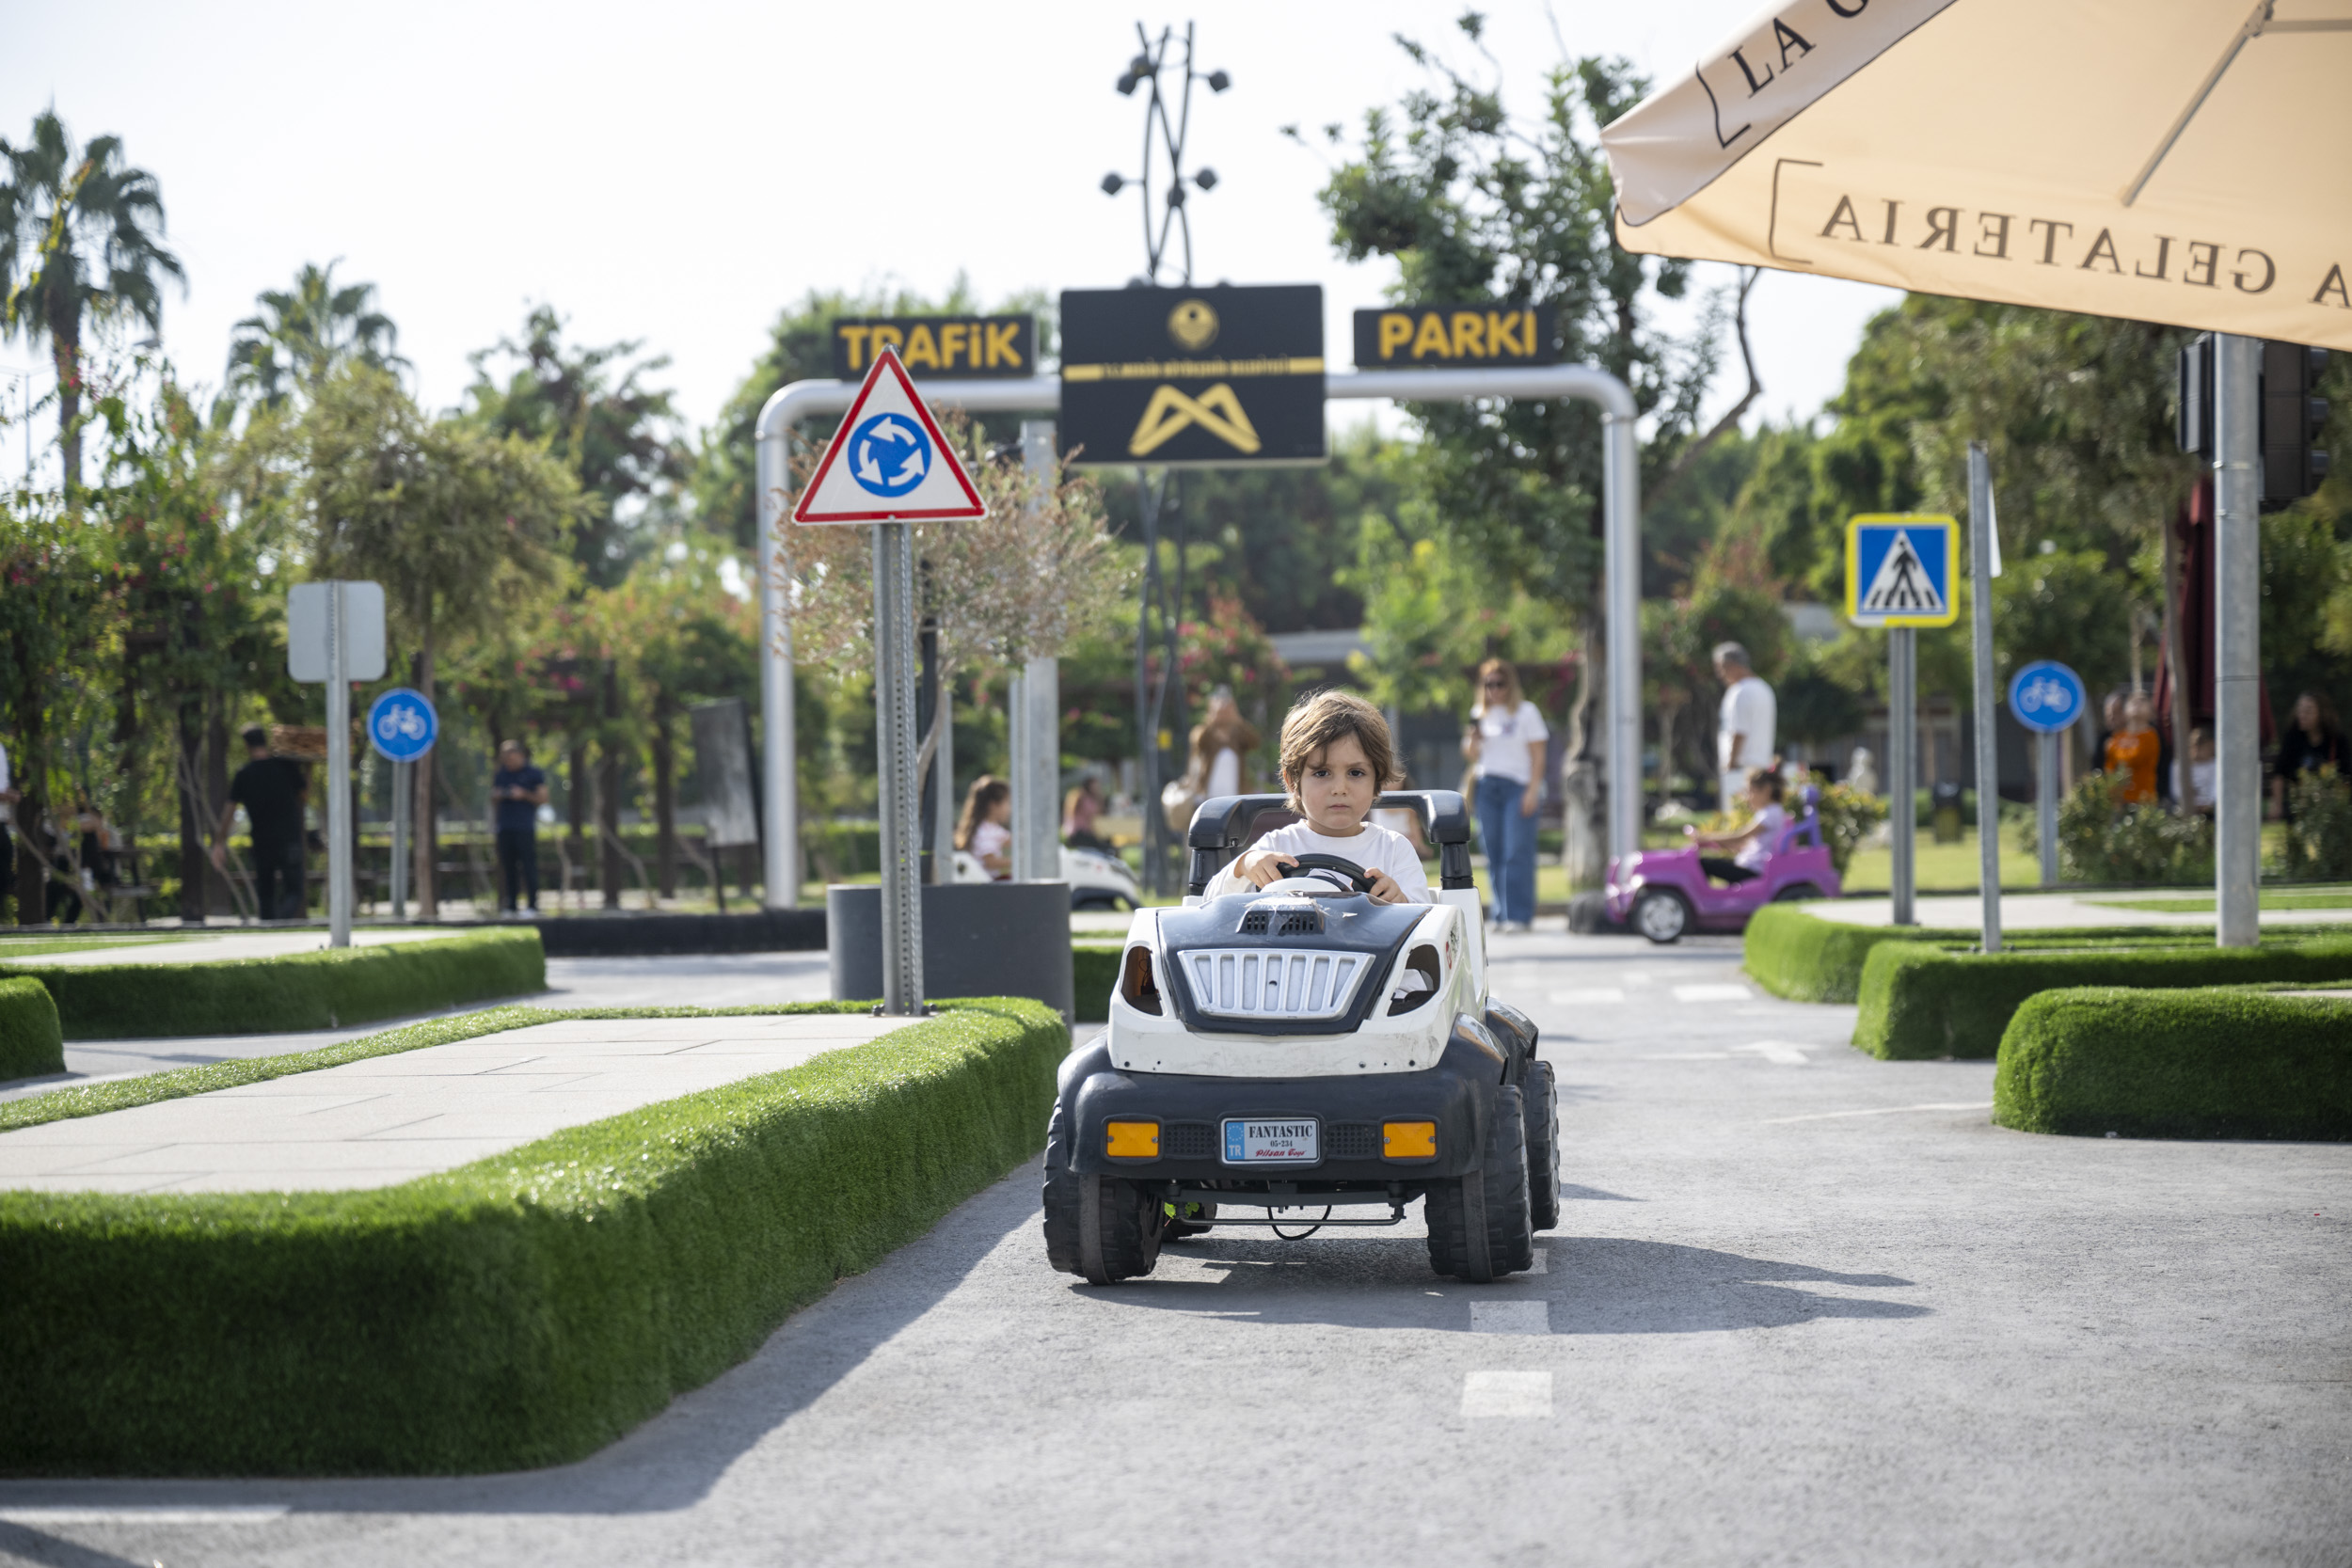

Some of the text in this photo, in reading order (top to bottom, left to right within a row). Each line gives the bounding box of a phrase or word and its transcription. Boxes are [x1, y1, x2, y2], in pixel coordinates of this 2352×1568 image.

[1727, 17, 1817, 99] LA
[1378, 309, 1538, 360] PARKI
[1249, 1125, 1312, 1138] FANTASTIC
[1229, 1145, 1242, 1156] TR
